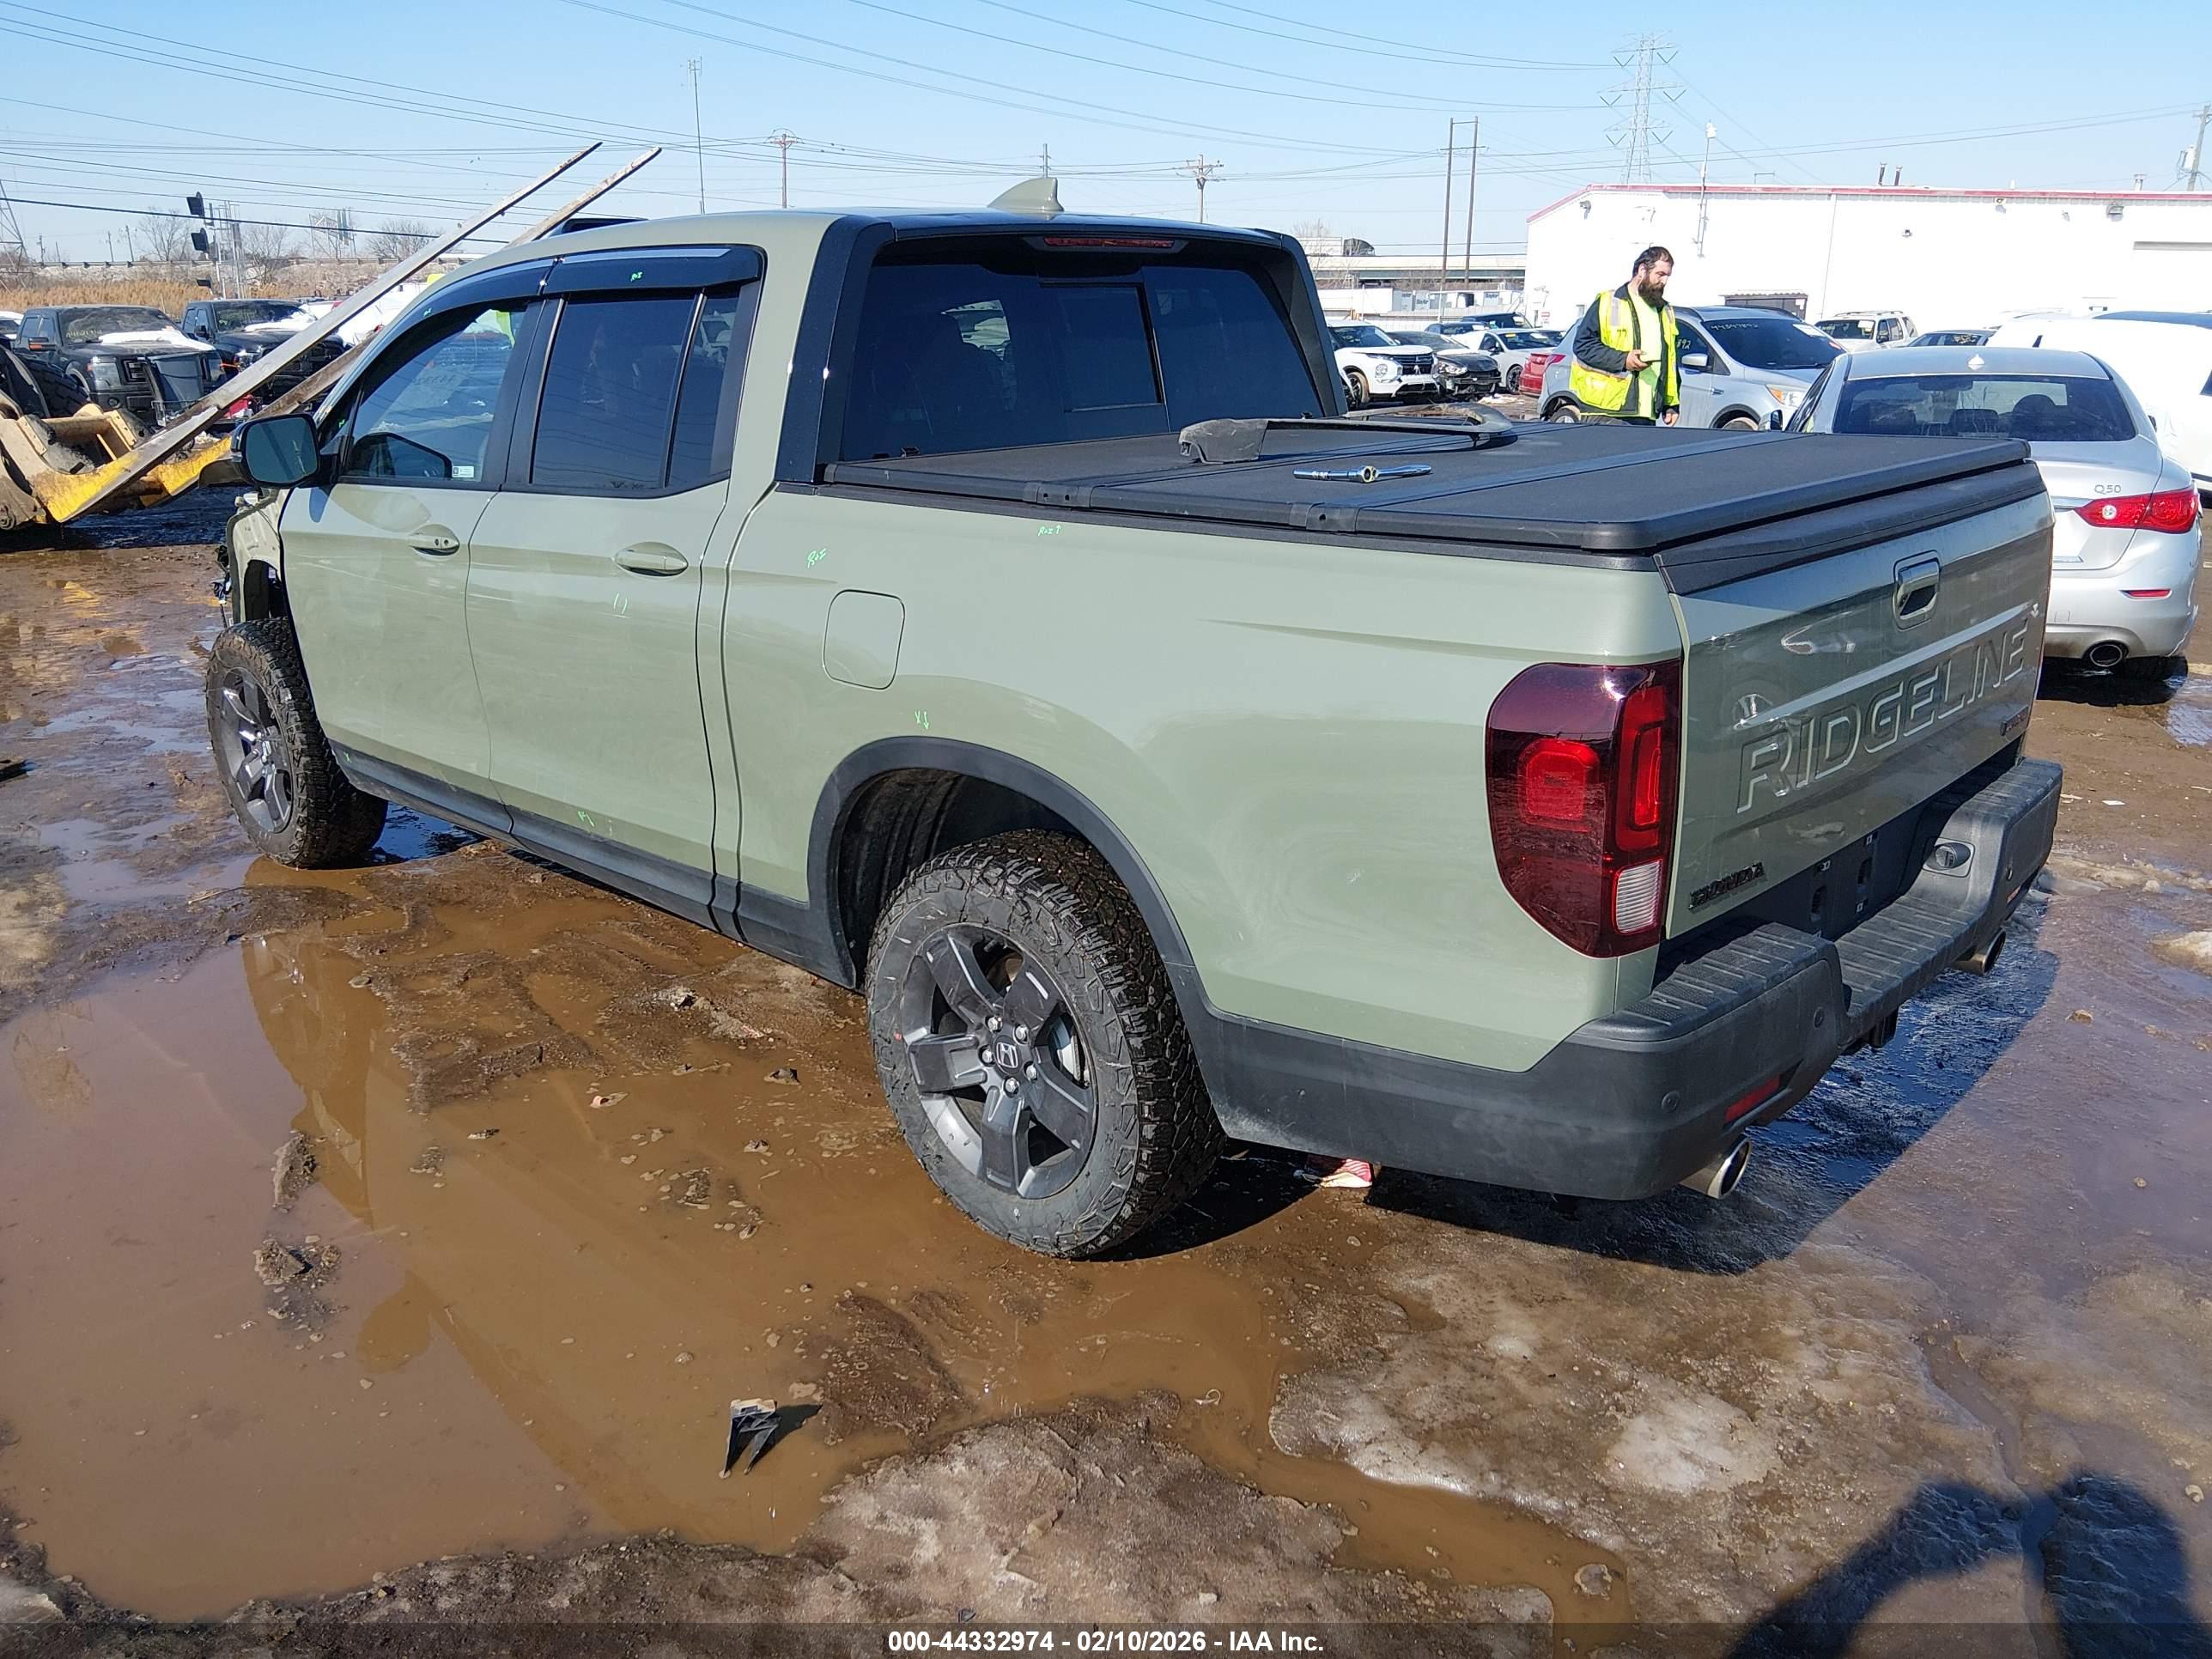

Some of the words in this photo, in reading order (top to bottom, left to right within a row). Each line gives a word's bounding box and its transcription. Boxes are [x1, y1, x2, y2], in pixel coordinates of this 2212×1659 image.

[2094, 484, 2122, 494] Q50
[1736, 617, 2029, 814] RIDGELINE
[1687, 860, 1766, 911] HONDA
